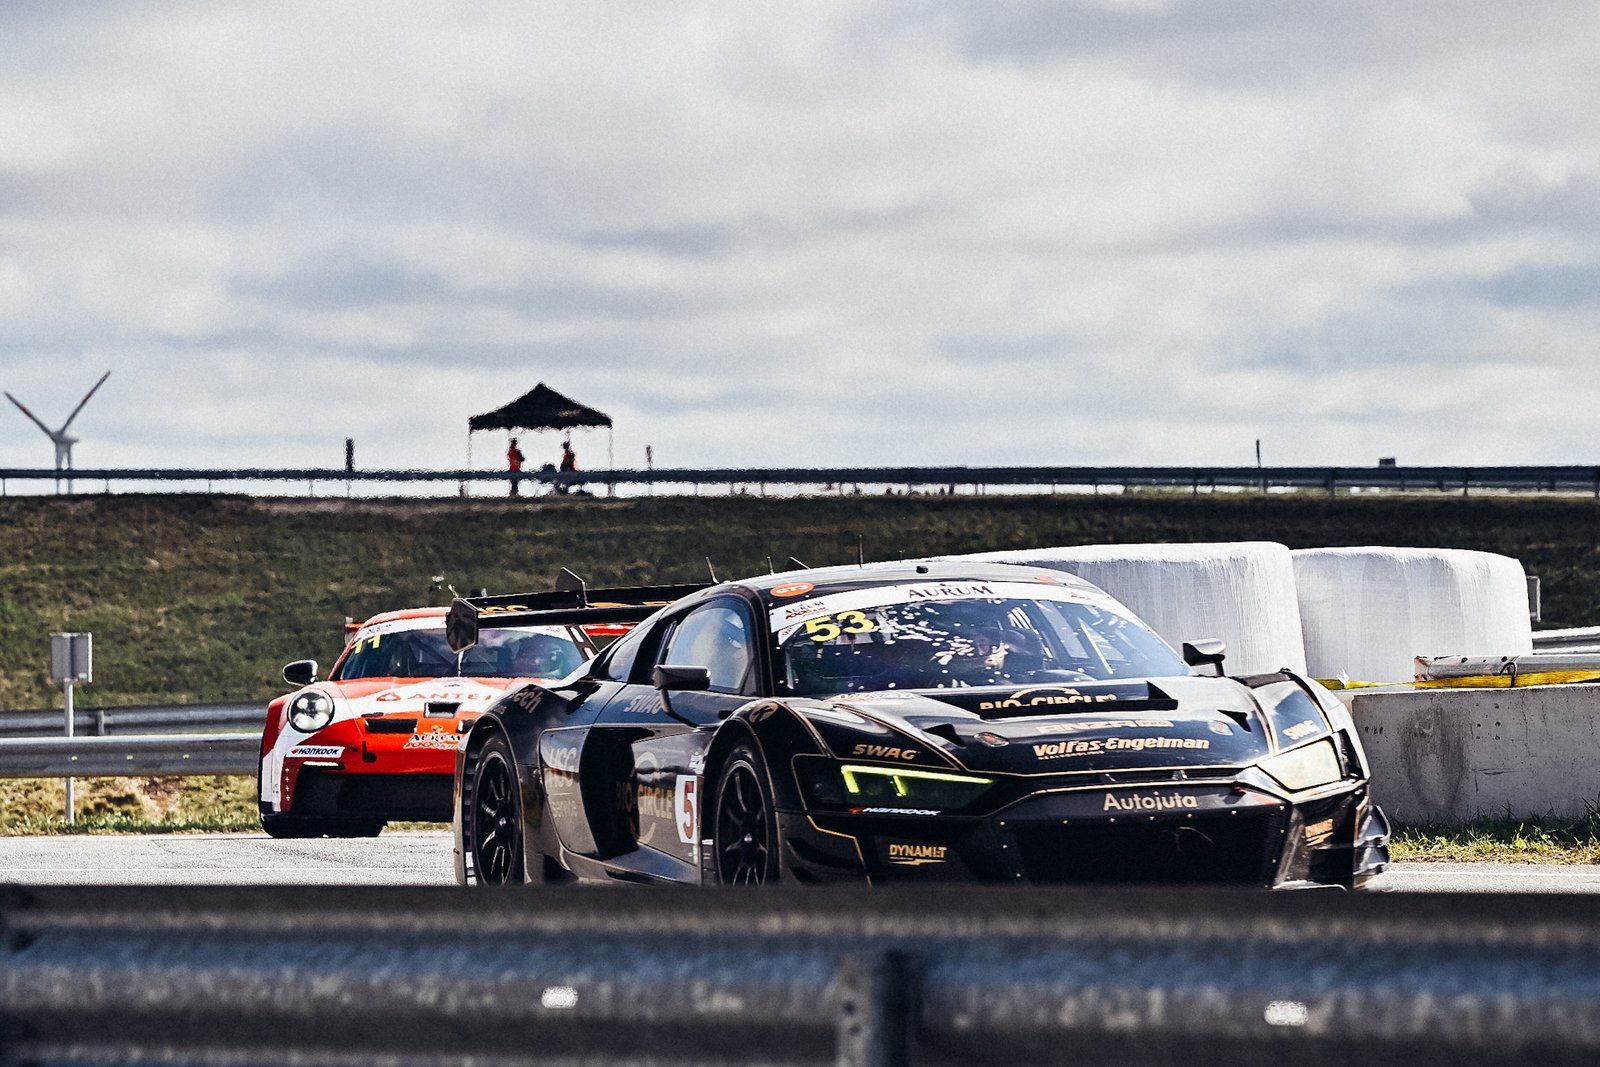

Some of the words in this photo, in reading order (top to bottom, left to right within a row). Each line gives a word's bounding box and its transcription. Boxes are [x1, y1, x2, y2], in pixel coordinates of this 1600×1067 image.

[909, 585, 995, 599] AURUM
[805, 610, 875, 642] 53
[351, 634, 381, 654] 11
[852, 744, 918, 760] SWAG
[1033, 737, 1211, 758] Volfas-Engelman
[1103, 791, 1198, 811] Autojuta
